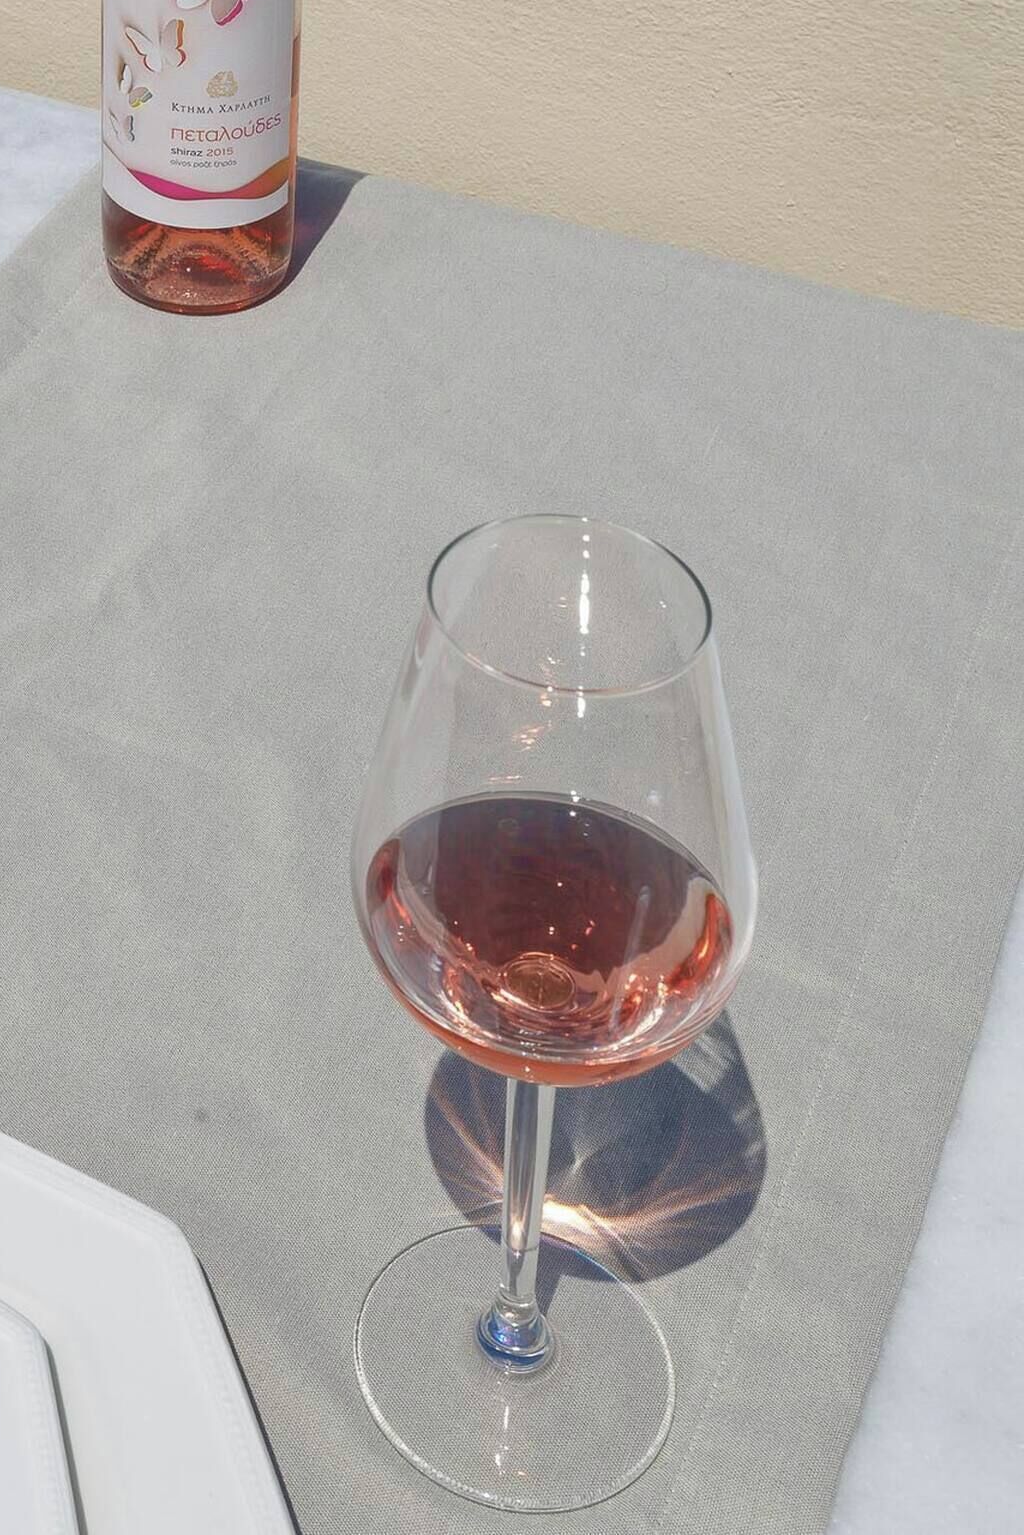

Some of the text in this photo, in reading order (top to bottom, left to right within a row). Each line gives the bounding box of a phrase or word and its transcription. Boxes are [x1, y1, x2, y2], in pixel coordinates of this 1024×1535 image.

[171, 113, 282, 142] πεταλούδες
[170, 147, 234, 157] shiraz 2015
